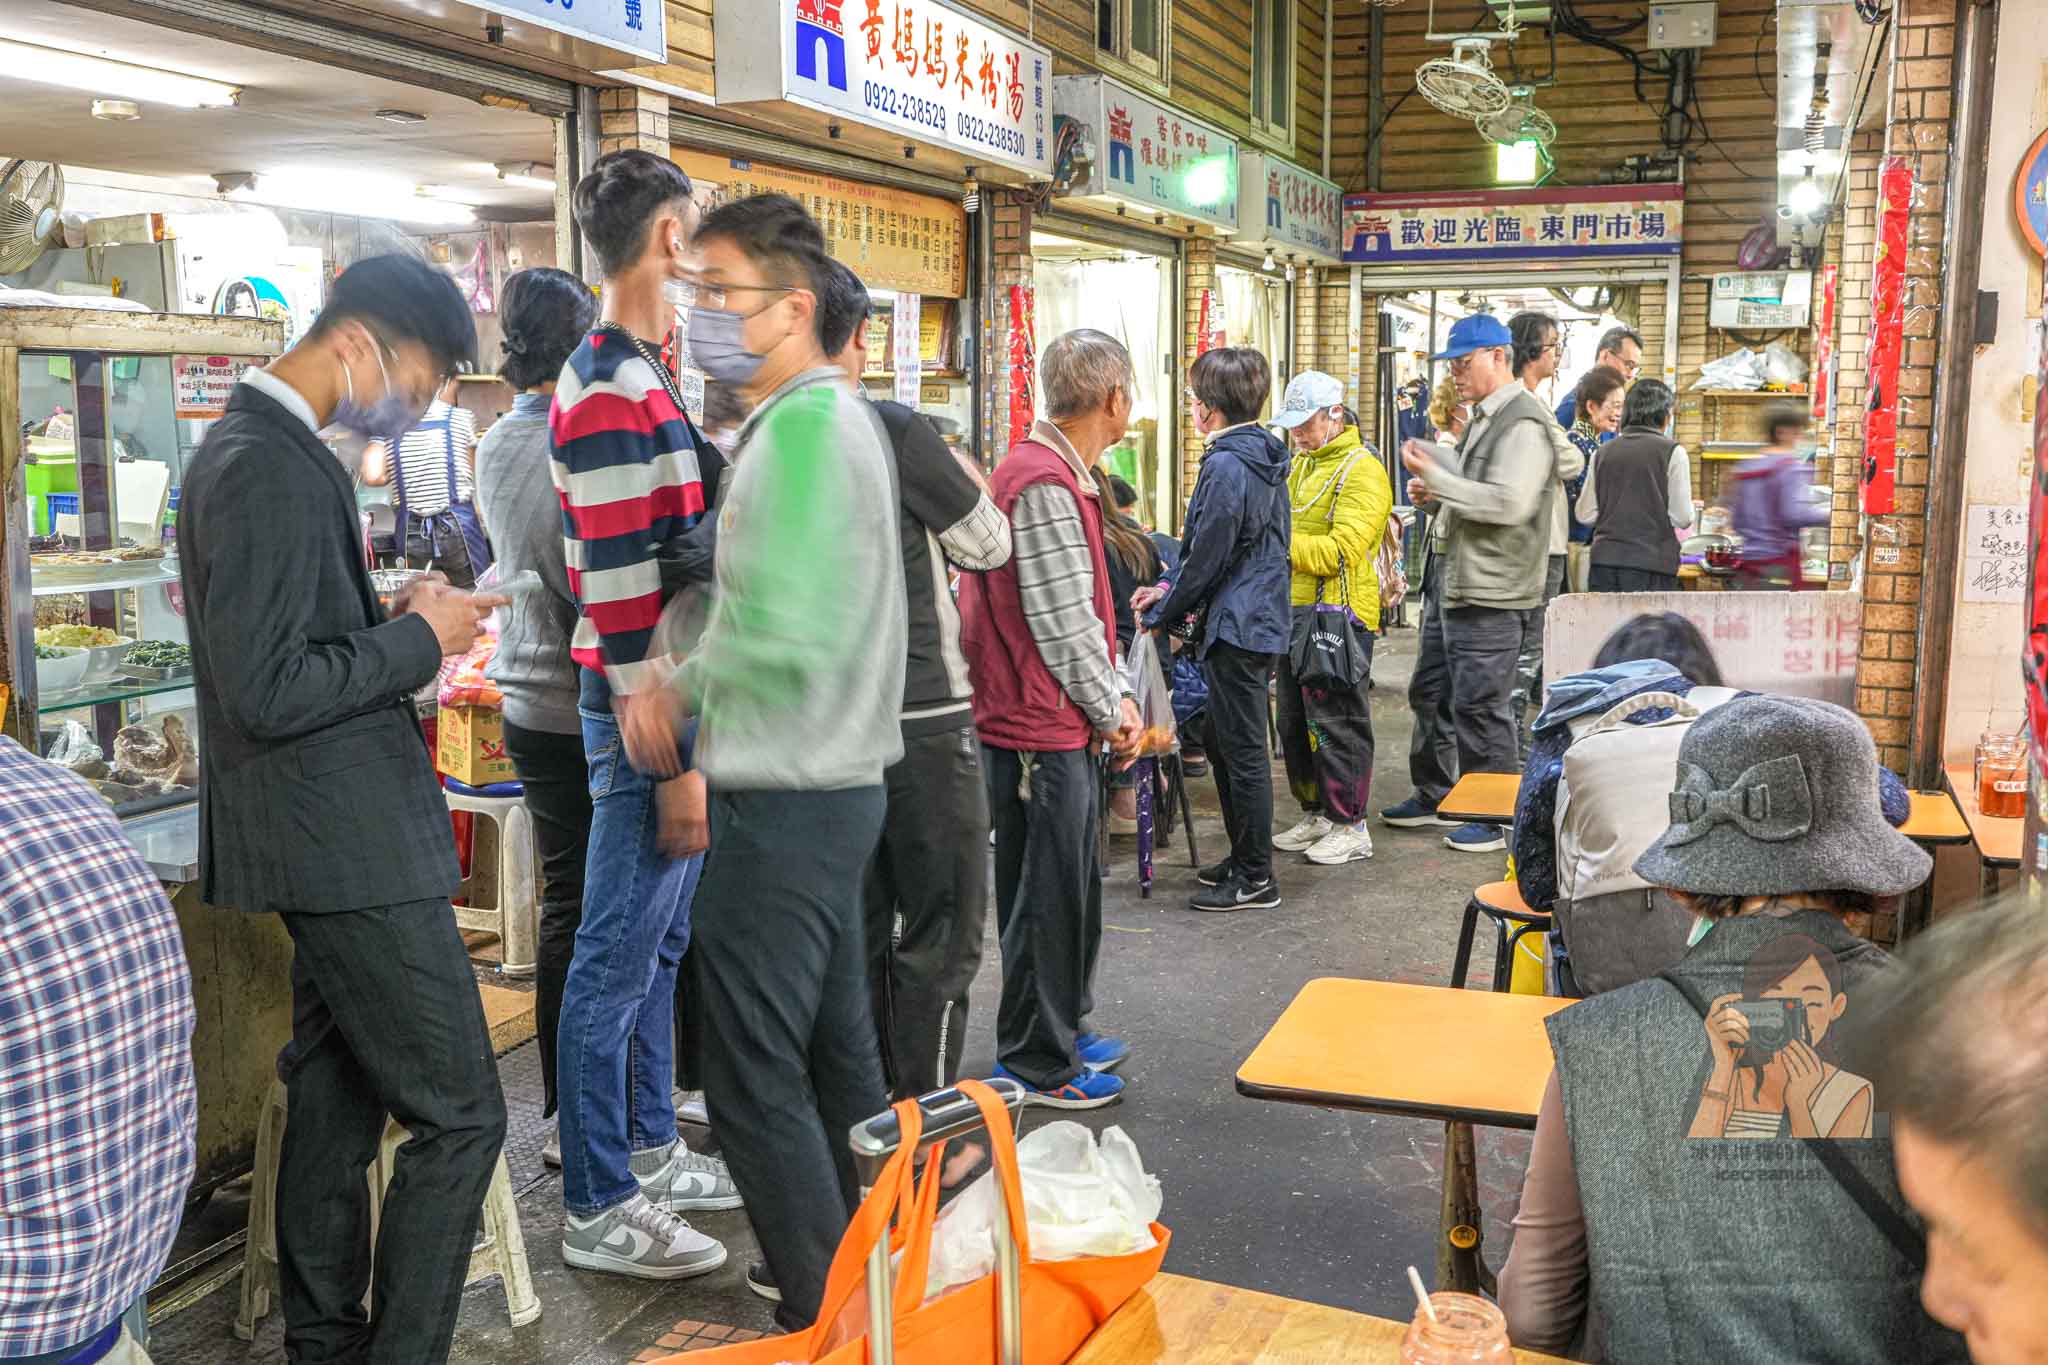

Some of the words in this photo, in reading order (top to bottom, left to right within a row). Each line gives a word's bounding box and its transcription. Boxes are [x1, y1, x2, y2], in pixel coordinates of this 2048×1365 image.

[860, 0, 1025, 124] 黃媽媽米粉湯
[864, 79, 946, 130] 0922-238529
[957, 111, 1025, 157] 0922-238530
[1156, 112, 1208, 157] 客家口味
[1400, 216, 1522, 245] 歡迎光臨
[1539, 212, 1667, 241] 東門市場
